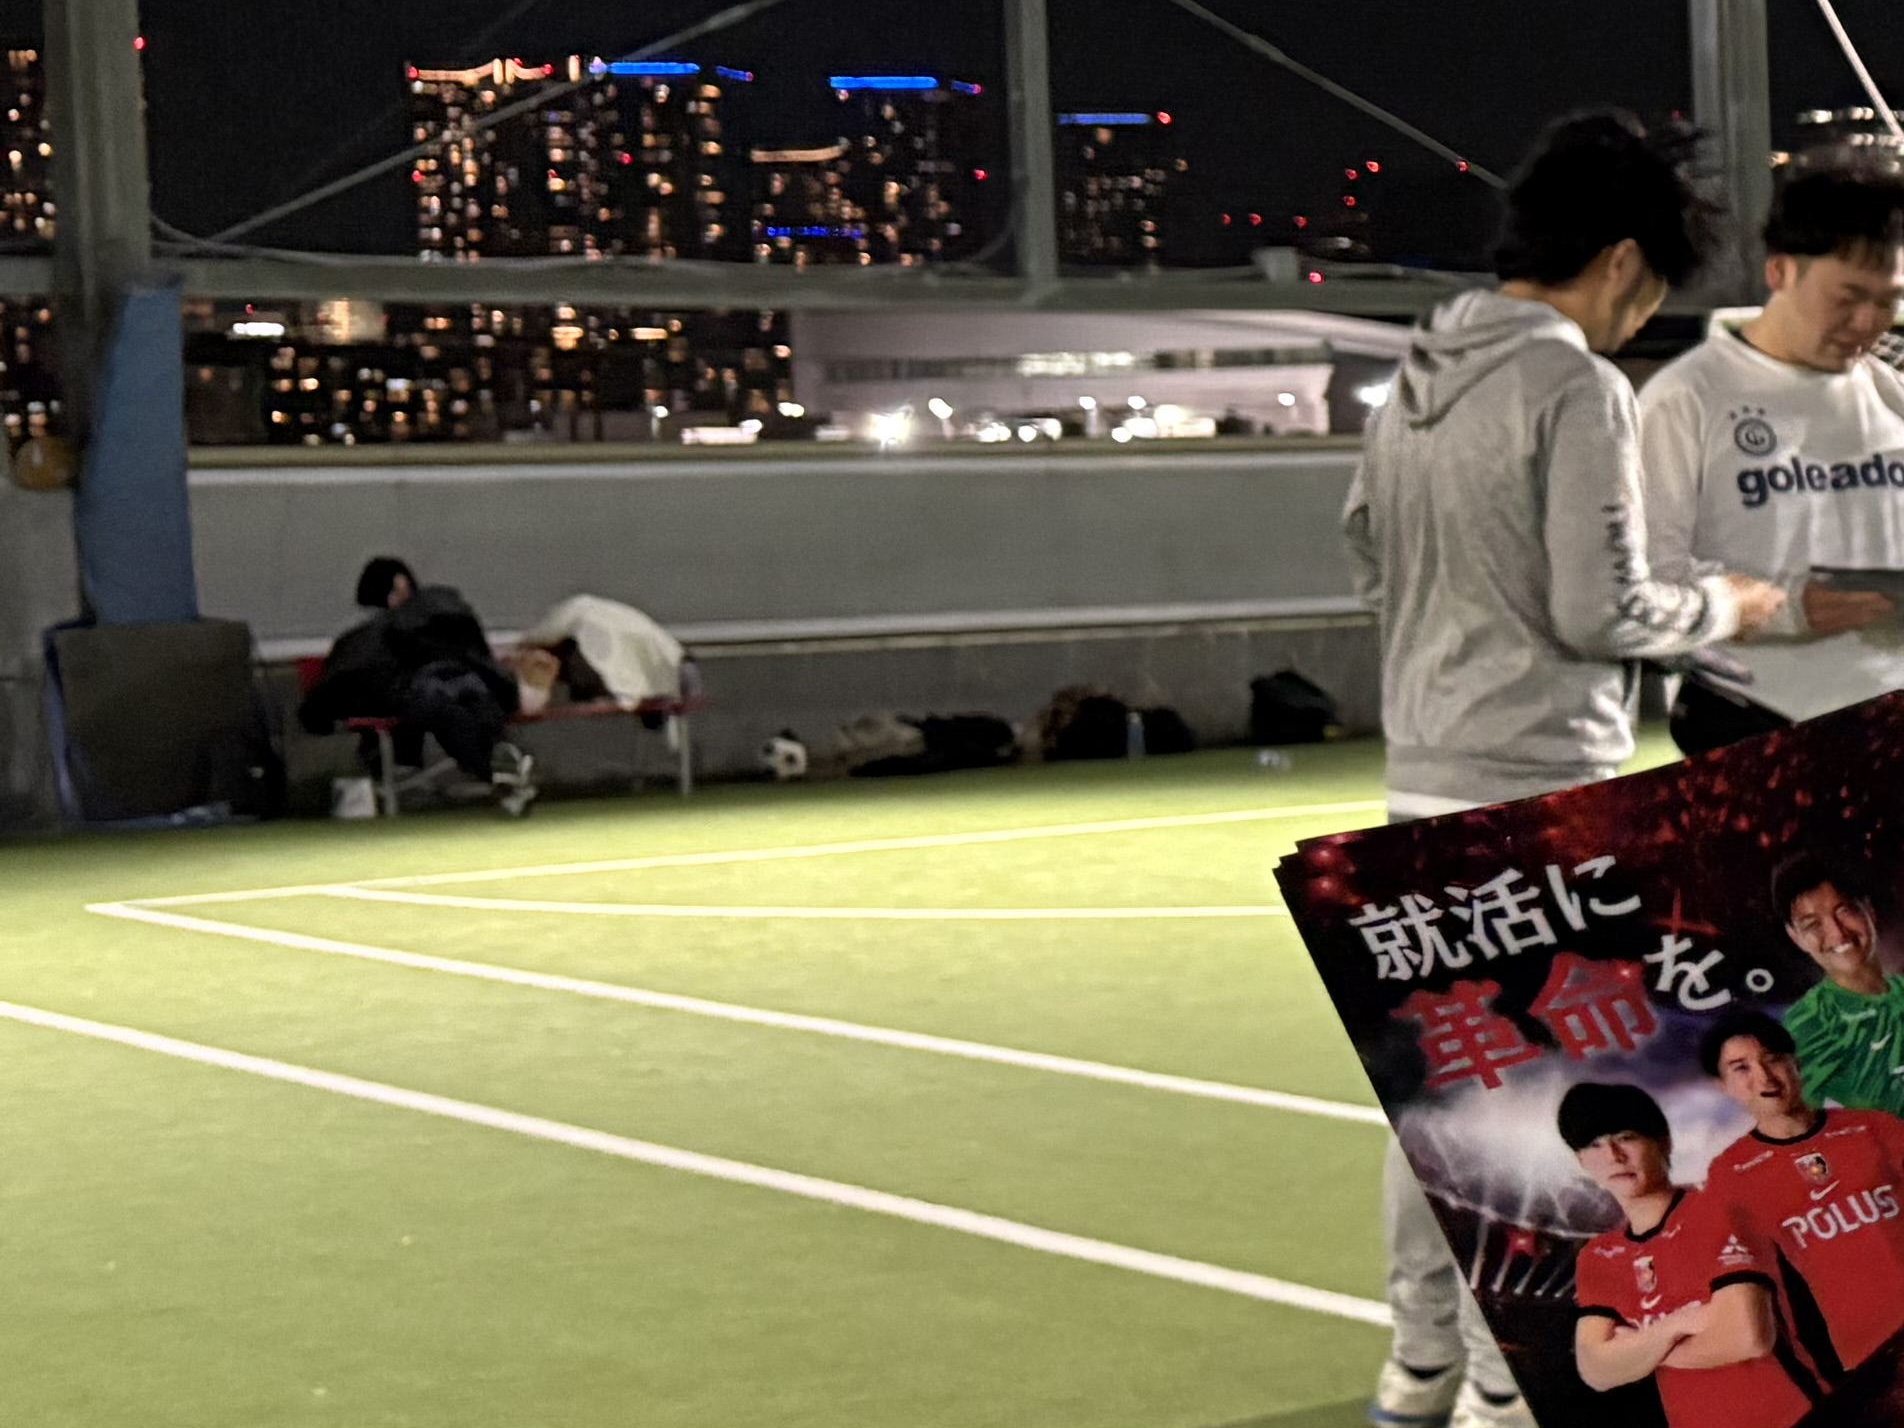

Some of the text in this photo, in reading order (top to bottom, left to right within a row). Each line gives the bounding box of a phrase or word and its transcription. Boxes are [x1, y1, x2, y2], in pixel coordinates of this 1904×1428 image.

[1349, 855, 1641, 980] 就活に
[1782, 1184, 1900, 1249] POLUS
